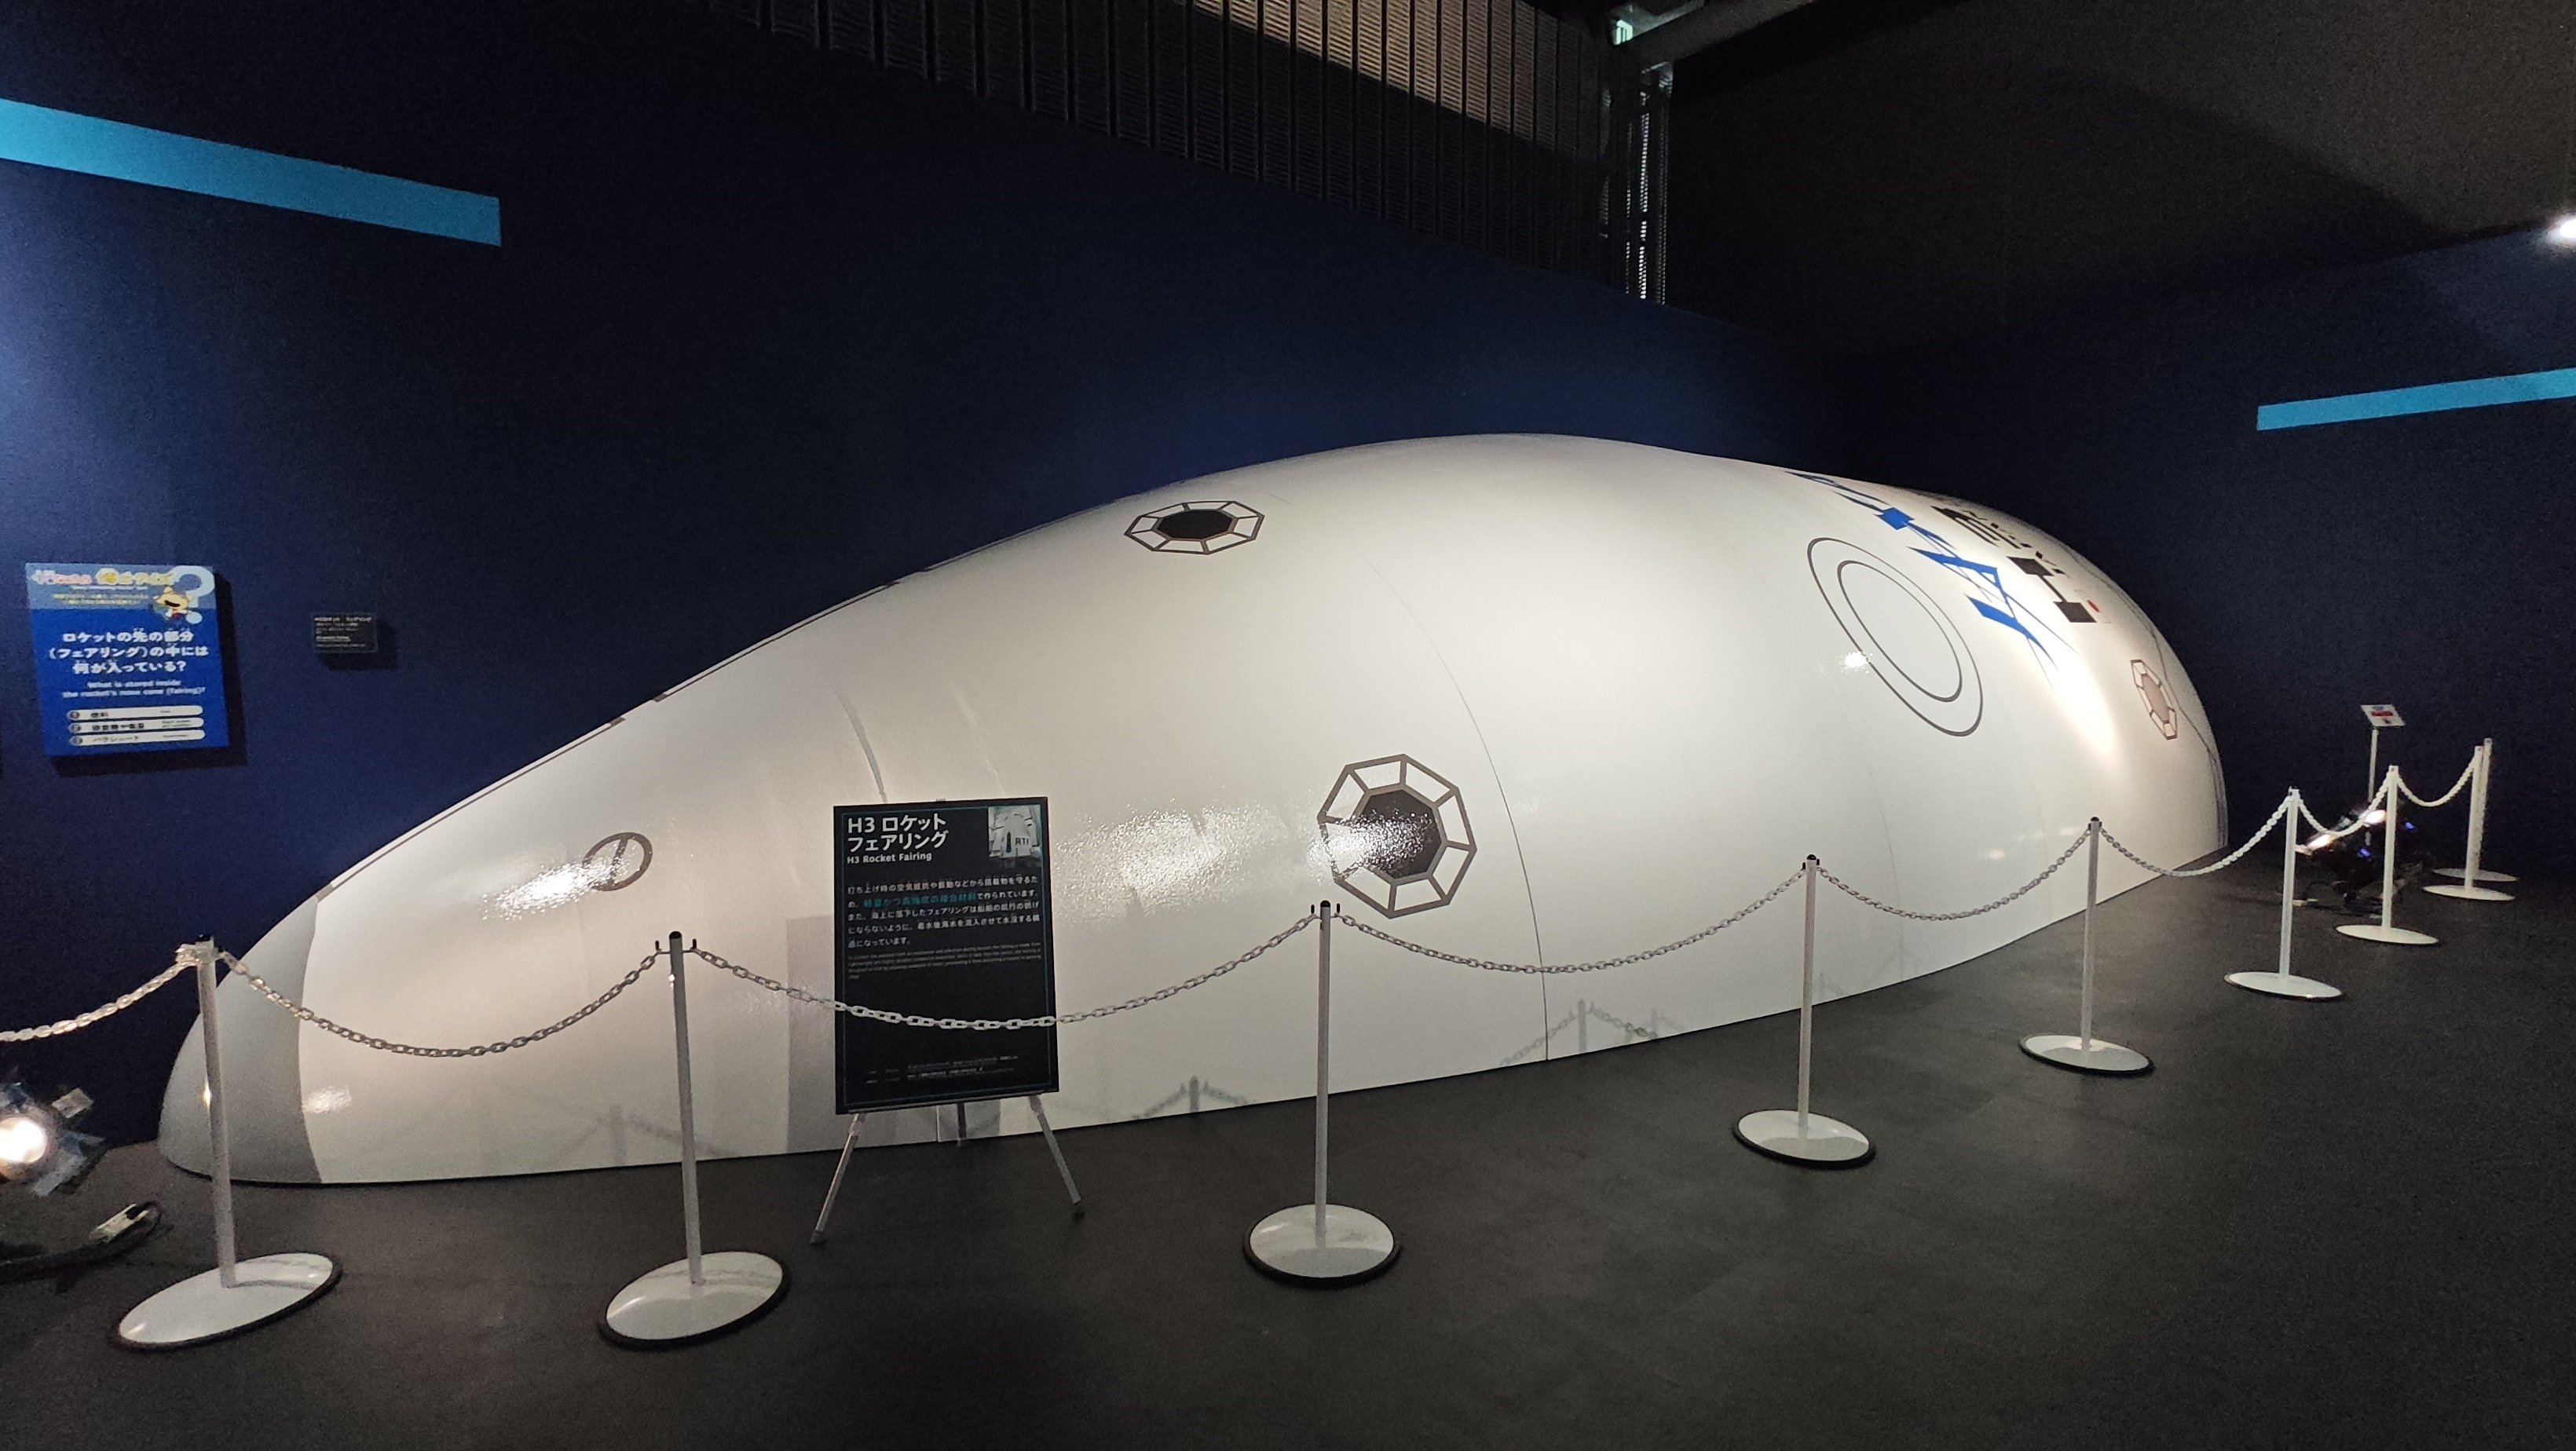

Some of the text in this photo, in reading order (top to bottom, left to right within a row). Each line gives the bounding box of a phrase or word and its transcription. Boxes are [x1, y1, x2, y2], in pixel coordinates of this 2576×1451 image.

[848, 813, 946, 833] H3 ロケット
[847, 830, 950, 853] フェアリング
[847, 852, 932, 864] H3 Rocket Fairing
